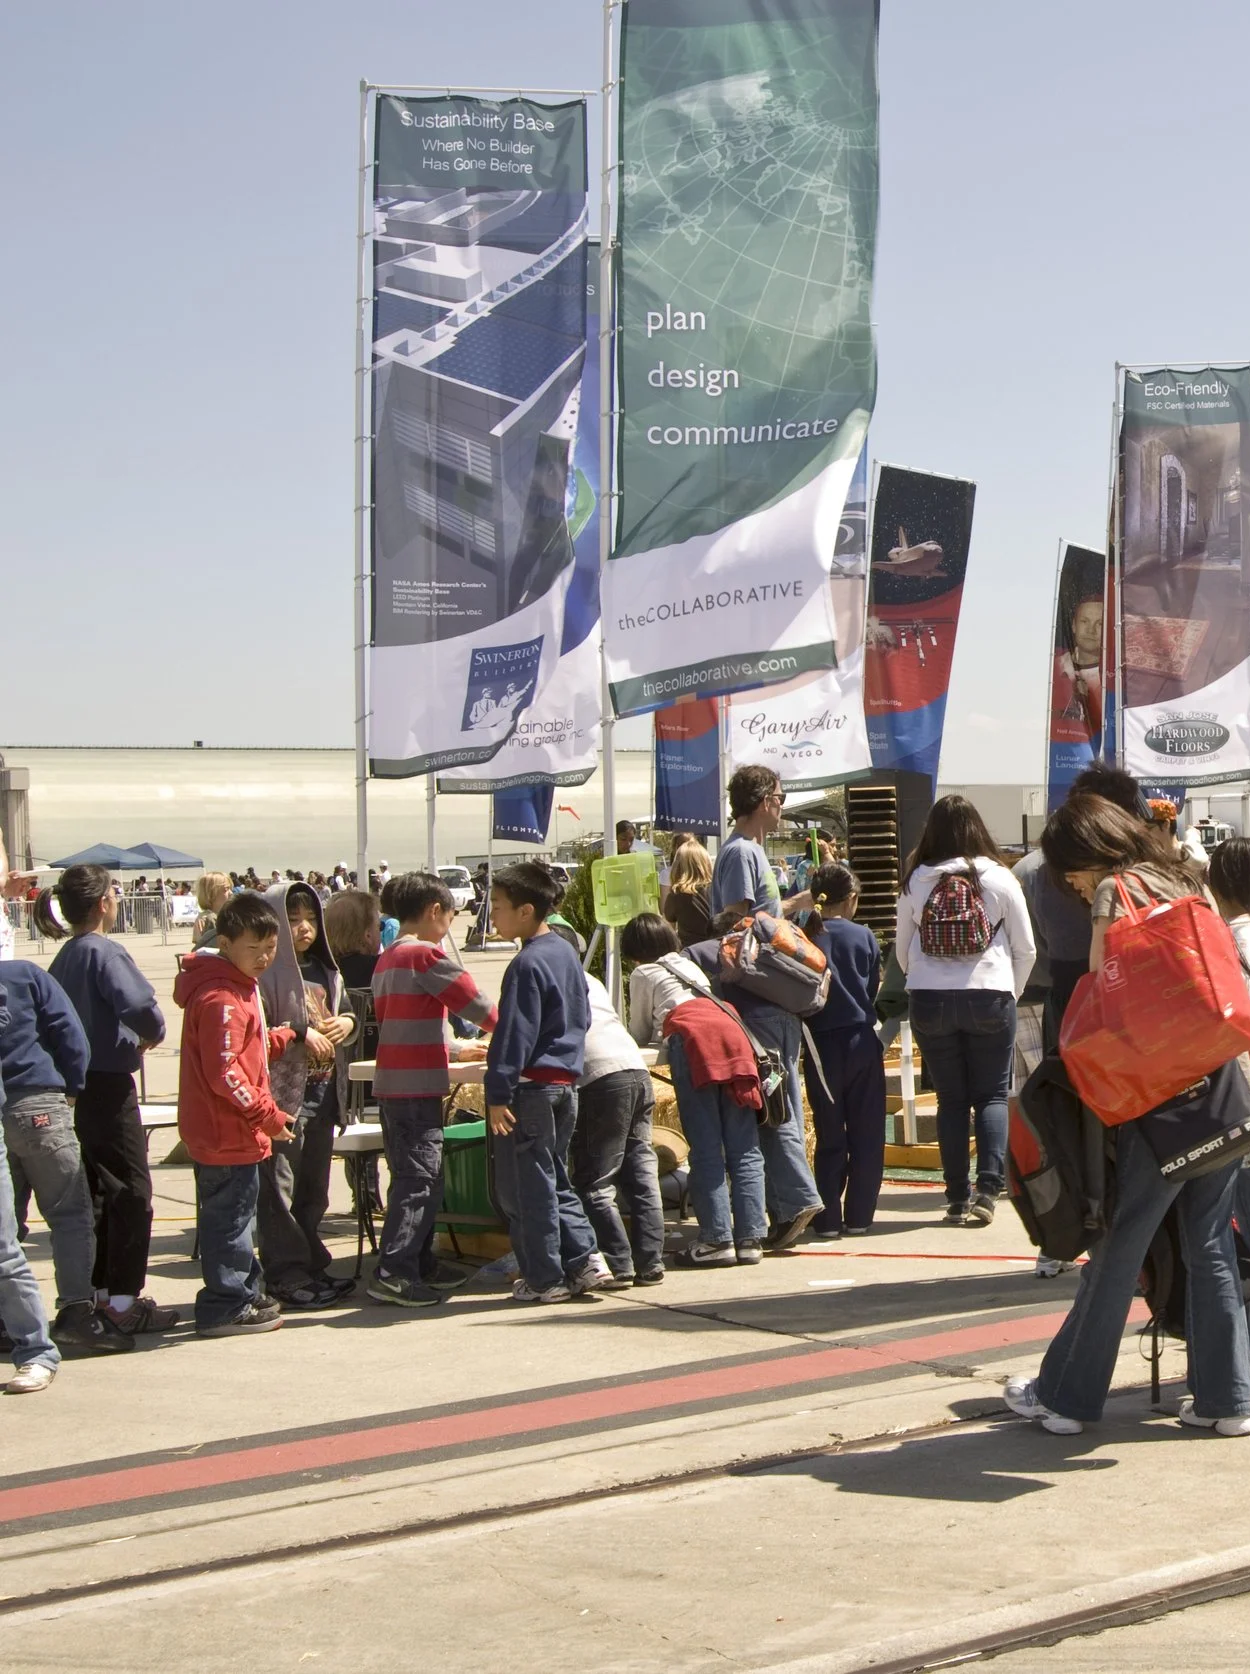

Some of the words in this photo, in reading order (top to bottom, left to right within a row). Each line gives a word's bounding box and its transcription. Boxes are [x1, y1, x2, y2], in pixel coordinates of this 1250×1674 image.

[400, 109, 509, 133] Sustainability
[513, 113, 555, 133] Base
[422, 138, 464, 152] Where
[466, 138, 486, 152] No
[490, 139, 536, 155] Builder
[423, 157, 450, 170] Has
[454, 158, 486, 171] Gone
[490, 158, 533, 174] Before
[646, 303, 706, 338] plan
[648, 361, 739, 396] design
[1144, 381, 1230, 397] Eco-Friendly
[1146, 402, 1163, 410] FSC
[1197, 400, 1230, 409] Materials
[647, 418, 839, 445] communicate
[618, 580, 804, 630] theCOLLABORATIVE
[643, 655, 798, 697] thecollaborative.com
[1157, 711, 1184, 723] SAN
[1185, 711, 1219, 723] JOSE
[533, 733, 567, 748] group
[1151, 726, 1224, 739] HARDWOOD
[1165, 739, 1211, 753] FLOORS
[1055, 753, 1081, 761] Lunar
[1160, 1156, 1187, 1176] POLO
[1186, 1136, 1224, 1162] SPORT
